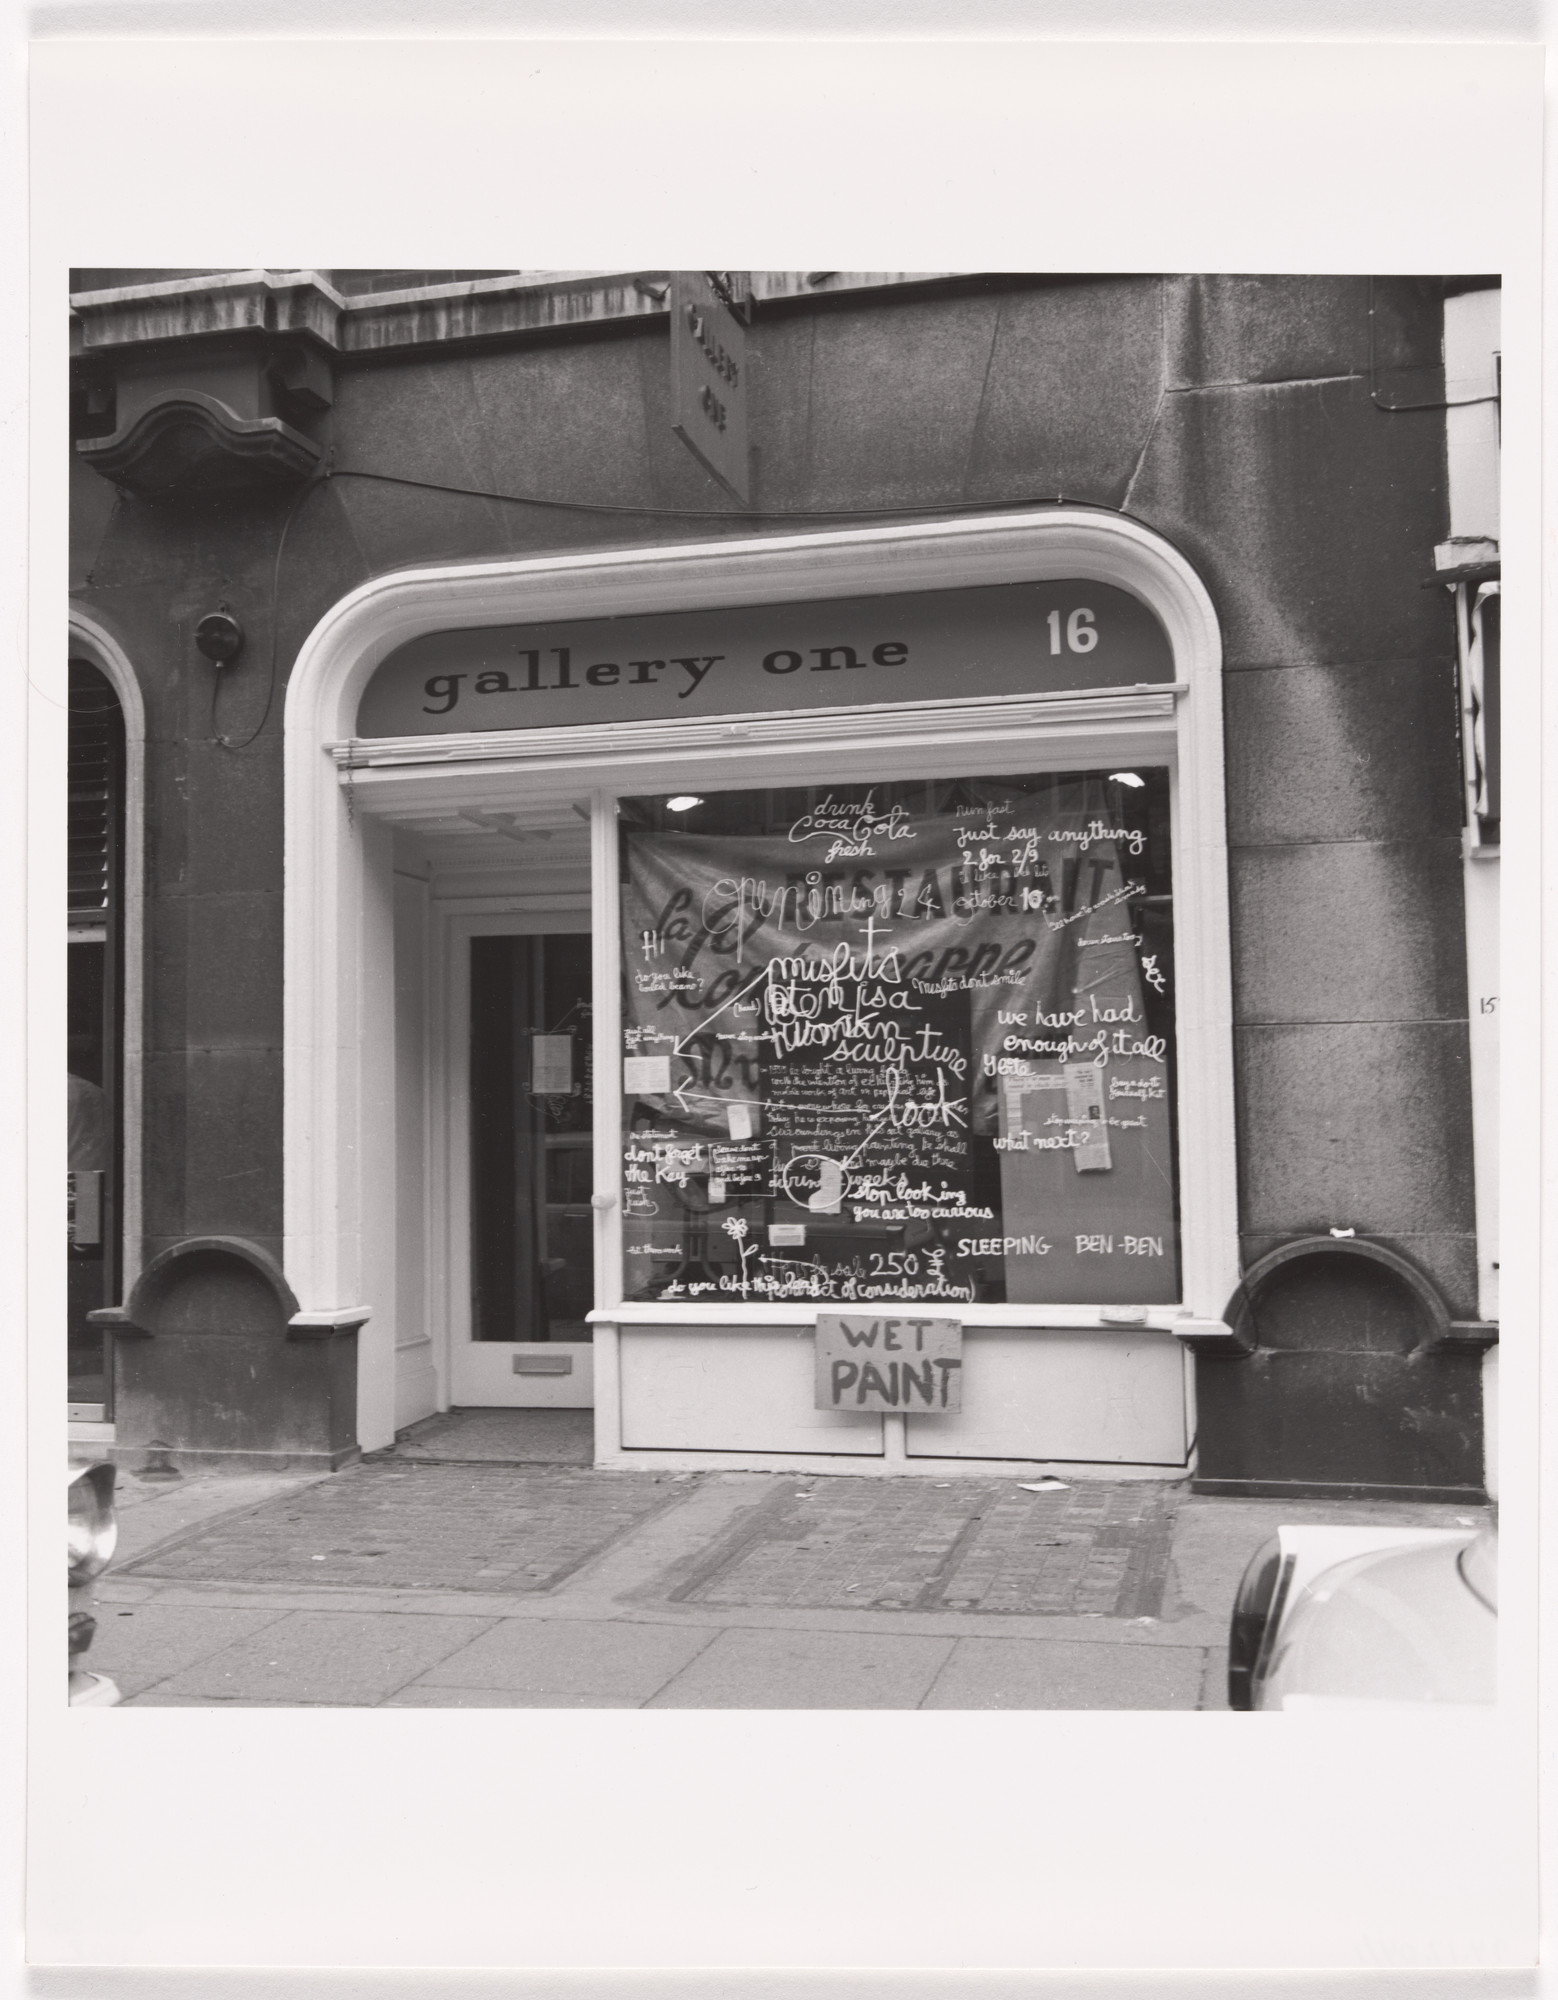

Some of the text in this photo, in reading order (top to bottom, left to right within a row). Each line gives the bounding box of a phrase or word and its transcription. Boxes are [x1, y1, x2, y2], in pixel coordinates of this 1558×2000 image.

[1046, 607, 1098, 656] 16
[422, 641, 910, 714] gallery one
[1003, 825, 1042, 848] say
[1048, 820, 1147, 855] anything
[978, 851, 1009, 871] for
[997, 993, 1142, 1028] we have had
[822, 1022, 968, 1081] sculpture
[1003, 1035, 1089, 1063] enough
[1088, 1029, 1110, 1067] of
[993, 1130, 1032, 1151] what
[664, 1143, 704, 1166] forget
[624, 1164, 654, 1183] the
[897, 1181, 967, 1205] looking
[931, 1206, 994, 1220] curious
[957, 1235, 1053, 1257] SLEEPING
[868, 1251, 920, 1276] 250
[688, 1281, 718, 1296] you
[839, 1320, 934, 1351] WET
[832, 1357, 962, 1408] PAINT
